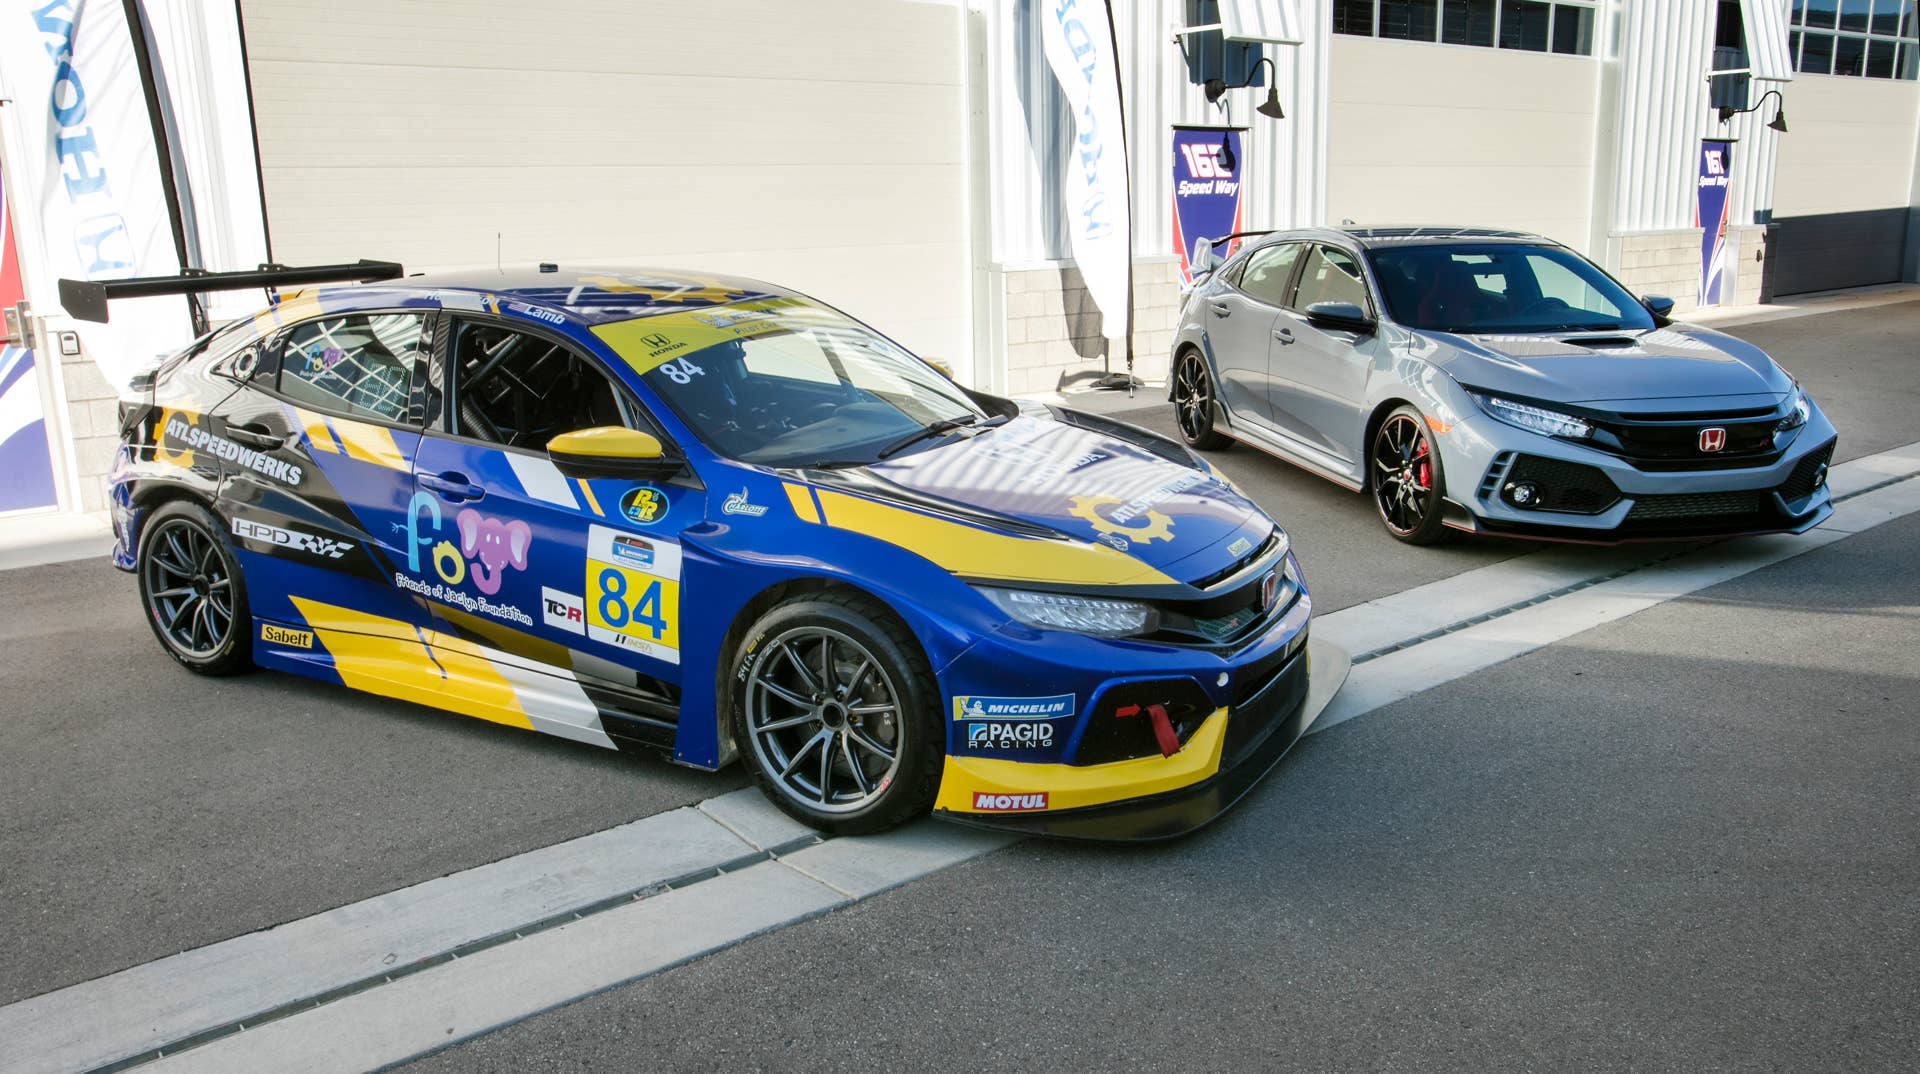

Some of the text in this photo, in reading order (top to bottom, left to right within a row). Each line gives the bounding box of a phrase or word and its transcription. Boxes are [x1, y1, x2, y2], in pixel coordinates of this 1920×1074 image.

[1177, 180, 1239, 197] Speed Way
[523, 305, 565, 325] Lamb
[648, 342, 688, 357] HONDA
[660, 357, 706, 385] 84
[165, 419, 302, 486] ATLSPEEDWERKS
[235, 522, 291, 544] HPD
[395, 573, 533, 627] Friends of Jaclyn Foundation
[598, 568, 667, 640] 84
[544, 598, 582, 623] TCR
[265, 626, 309, 647] Sabelt
[987, 702, 1065, 714] MICHELIN
[989, 723, 1054, 742] PAGID
[968, 738, 1053, 749] RACING
[975, 794, 1046, 809] MOTUL
